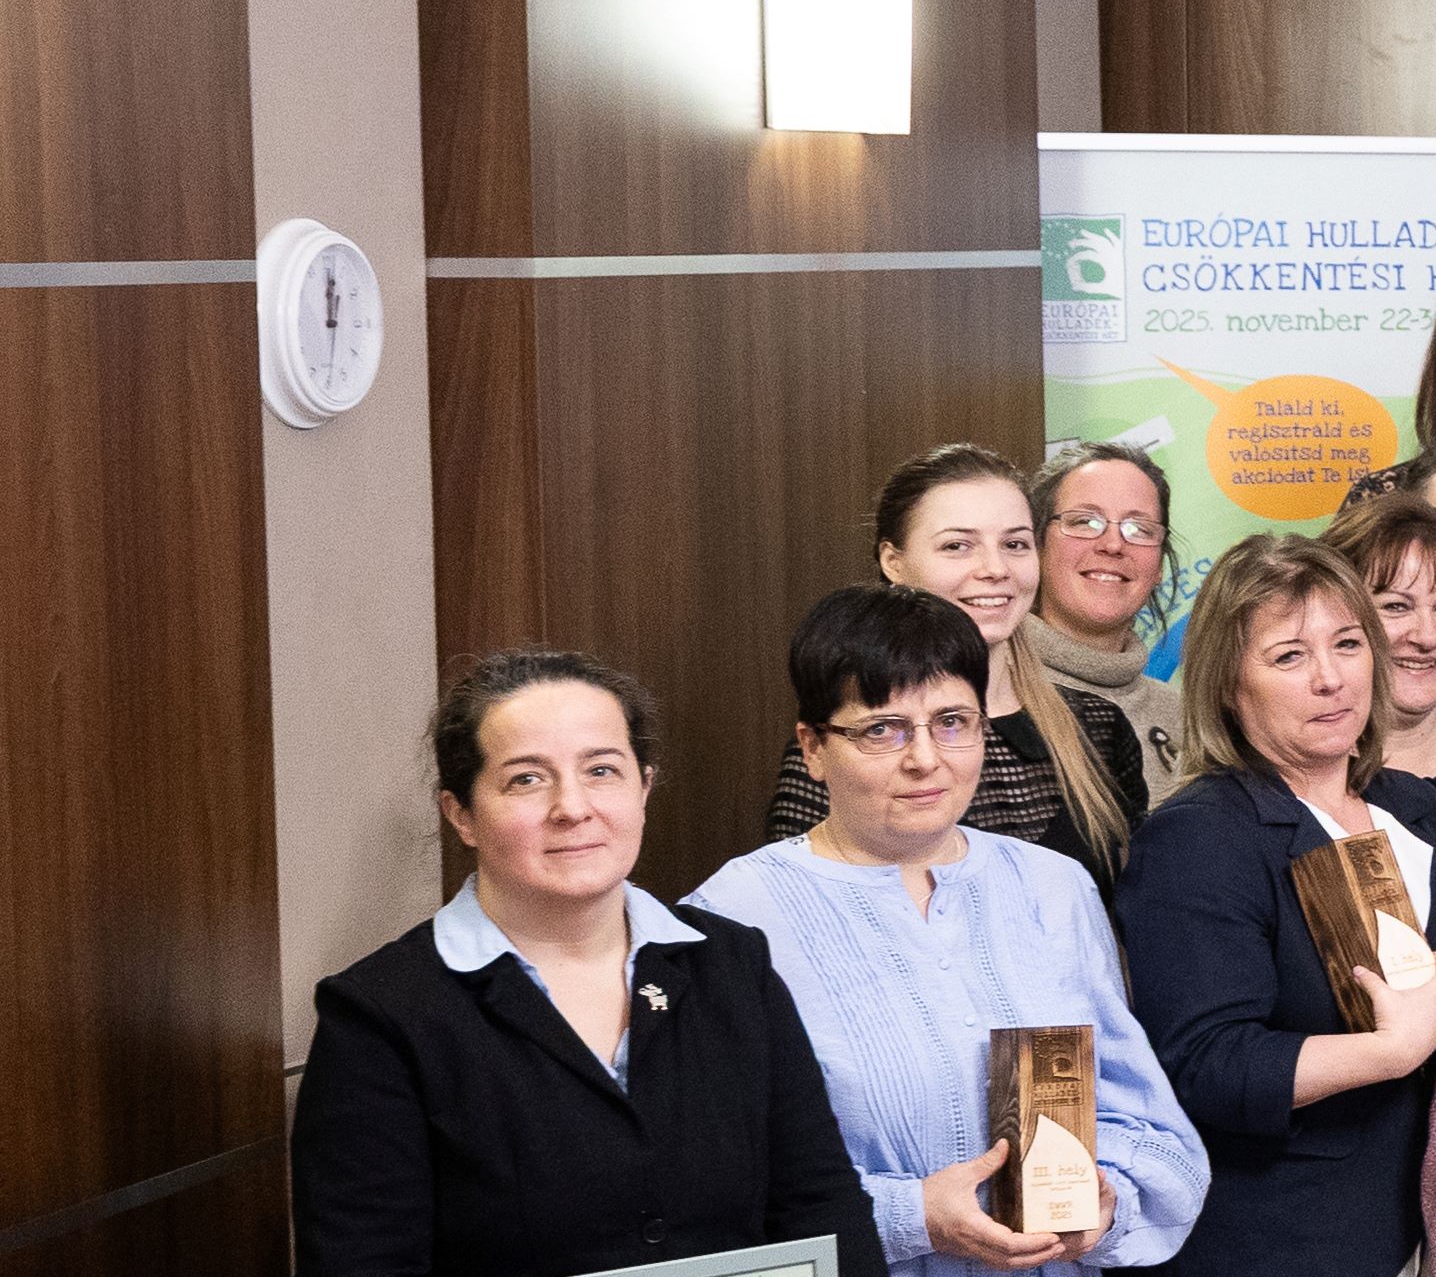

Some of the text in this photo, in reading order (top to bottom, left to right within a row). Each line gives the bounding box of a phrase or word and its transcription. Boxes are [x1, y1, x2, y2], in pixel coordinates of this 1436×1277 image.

[1141, 213, 1290, 249] EURÓPAI
[1142, 254, 1407, 292] CSÖKKENTÉSI
[1144, 307, 1434, 333] 2025. november 22-3
